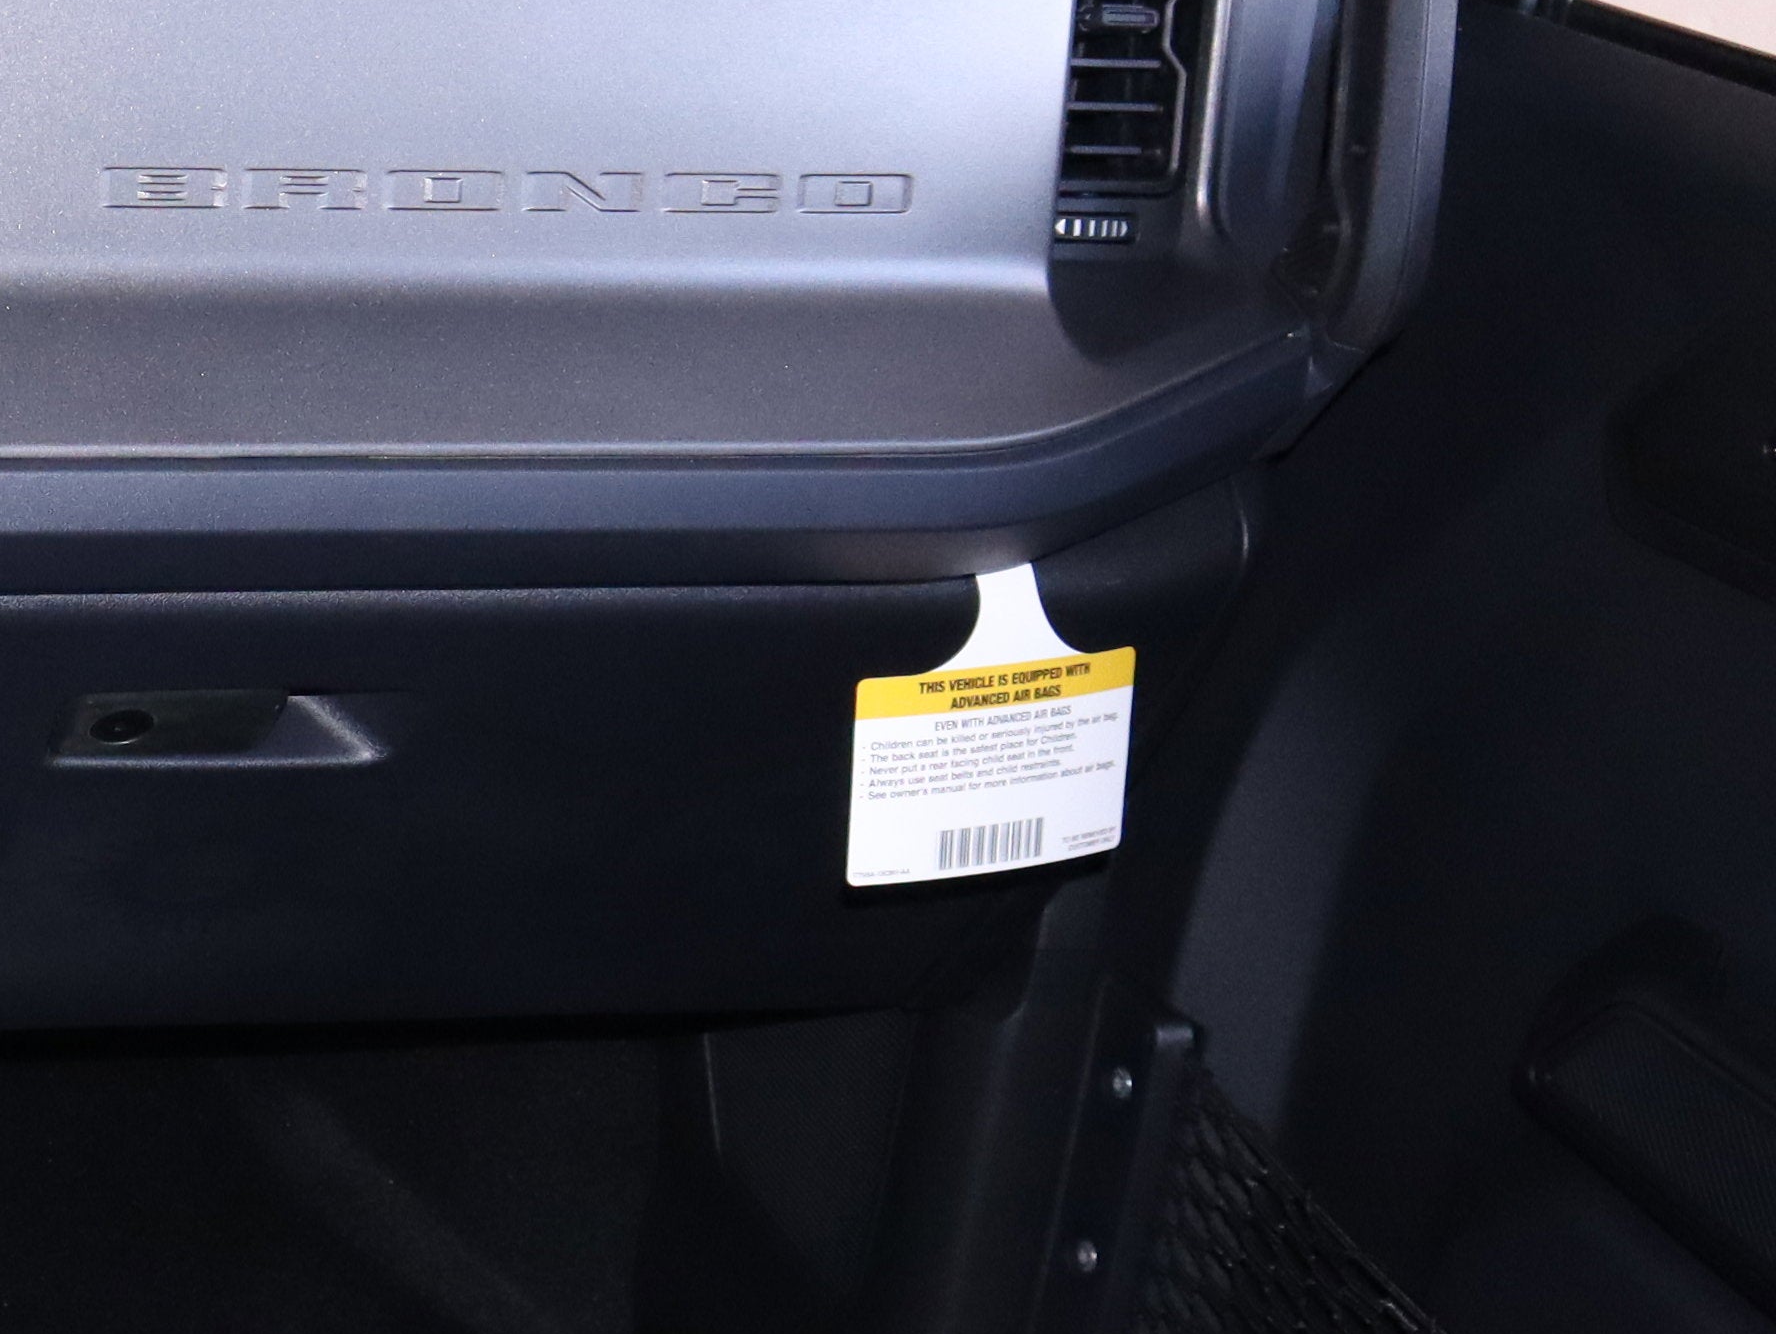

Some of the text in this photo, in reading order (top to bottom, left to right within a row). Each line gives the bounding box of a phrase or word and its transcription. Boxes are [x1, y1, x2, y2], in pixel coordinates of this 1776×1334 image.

[103, 167, 911, 214] BRONCO
[919, 662, 1091, 695] THIS VEHICLE IS EQUIPPED WITH
[950, 685, 1062, 709] ADVANCED AIR BAGS
